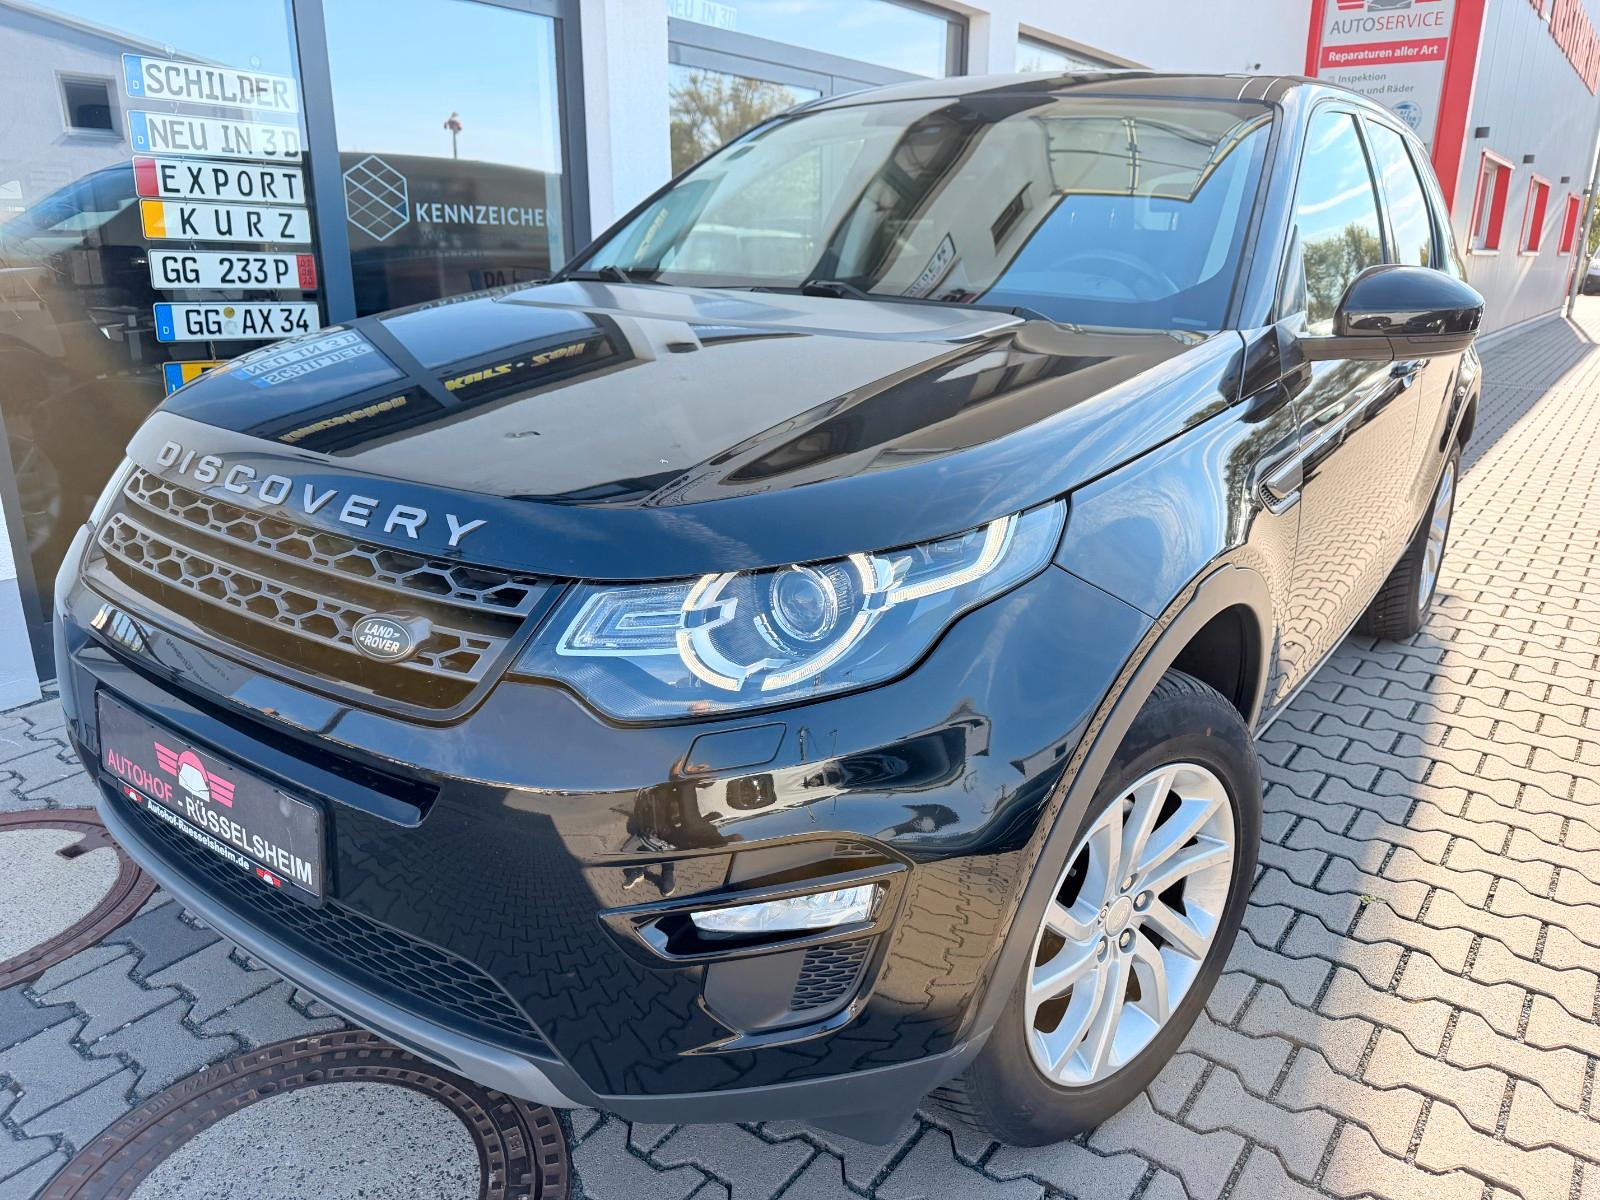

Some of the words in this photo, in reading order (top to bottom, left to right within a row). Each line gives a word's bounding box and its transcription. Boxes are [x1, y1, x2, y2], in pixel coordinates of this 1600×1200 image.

[1330, 11, 1445, 35] AUTOSERVICE
[1328, 49, 1393, 64] Reparaturen
[1394, 46, 1419, 57] aller
[1420, 44, 1439, 55] Art
[145, 64, 291, 109] SCHILDER
[1338, 72, 1387, 84] Inspektion
[1367, 85, 1385, 94] und
[148, 118, 208, 151] NEU
[221, 124, 252, 155] IN
[160, 164, 297, 200] EXPORT
[179, 208, 296, 239] KURZ
[161, 255, 200, 284] GG
[185, 309, 223, 336] GG
[155, 440, 488, 547] DISCOVERY
[364, 623, 394, 638] LAND
[364, 635, 400, 653] ROVER
[107, 748, 173, 802] AUTOHOF
[147, 800, 250, 870] Autohof-Ruesselsheim.de
